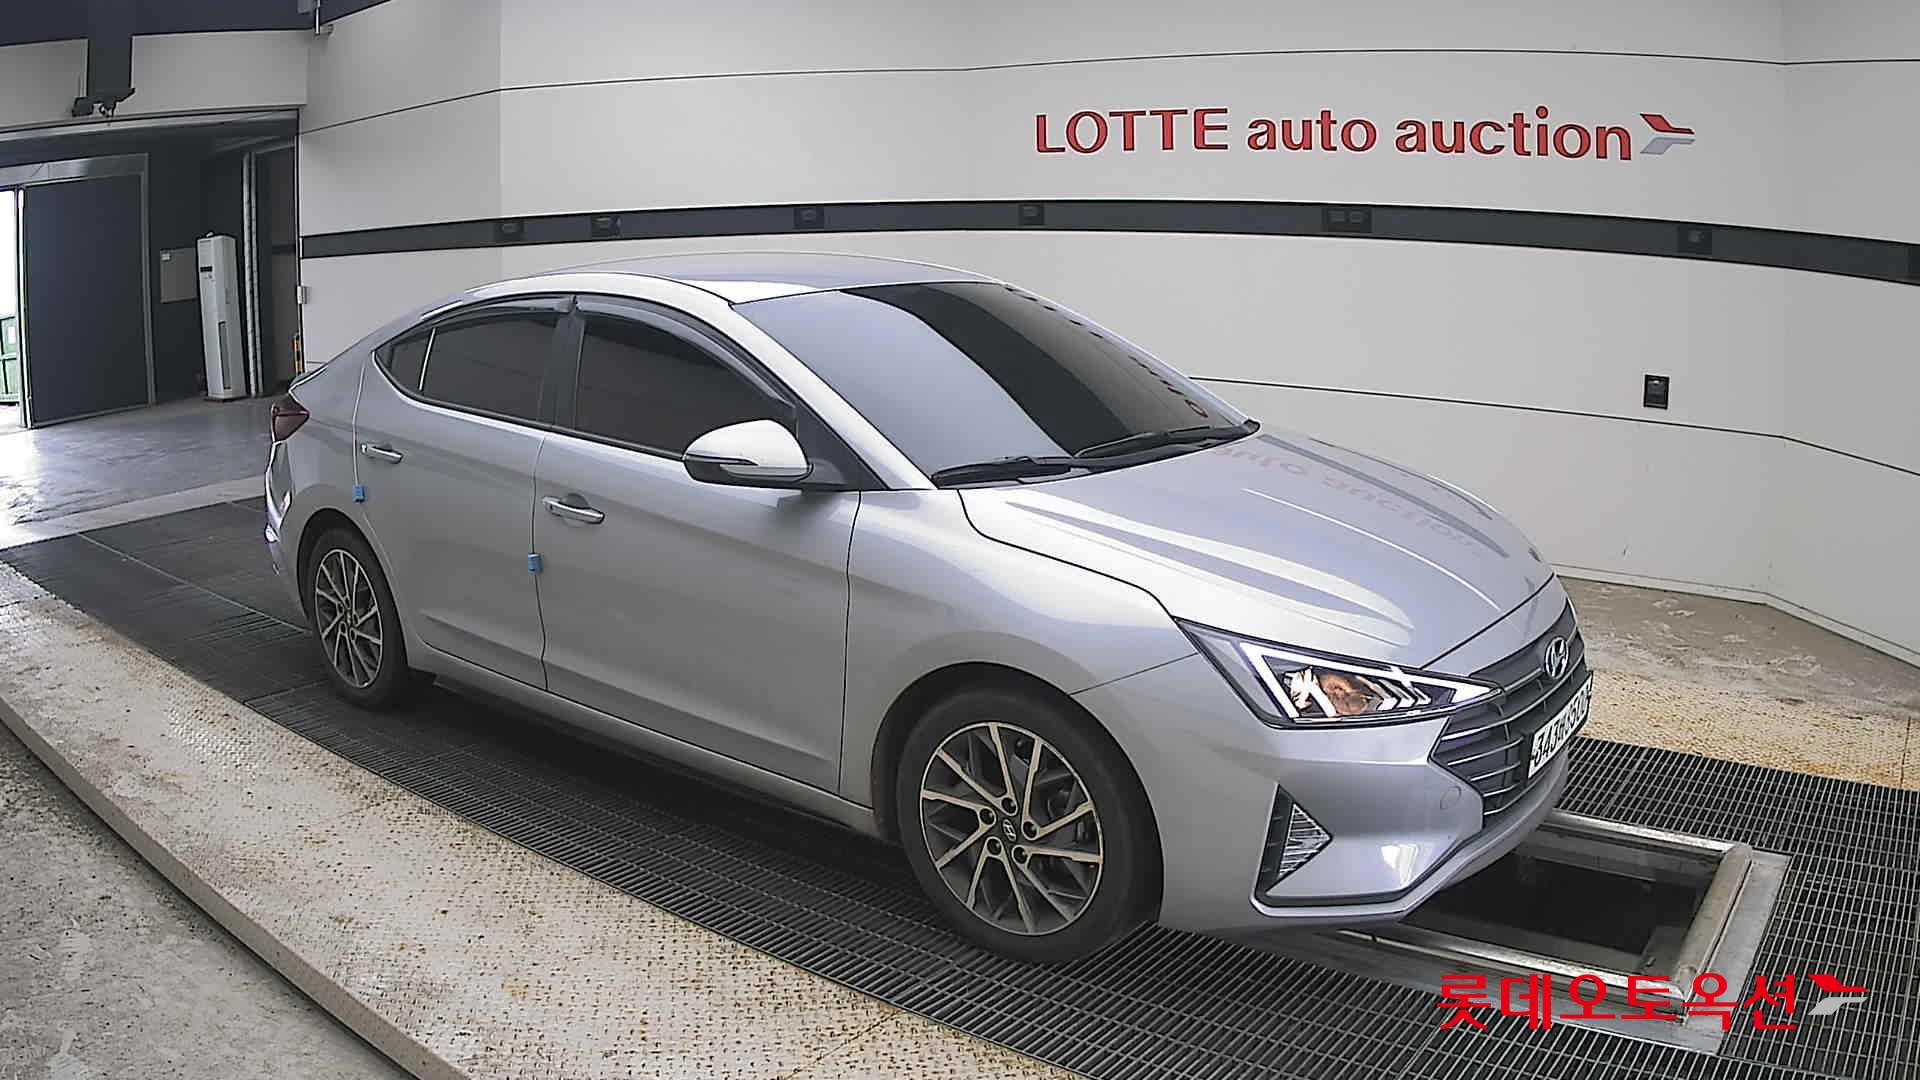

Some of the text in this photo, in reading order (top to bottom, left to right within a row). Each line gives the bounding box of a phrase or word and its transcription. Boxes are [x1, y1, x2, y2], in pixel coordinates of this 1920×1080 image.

[1035, 105, 1633, 161] LOTTE auto auction
